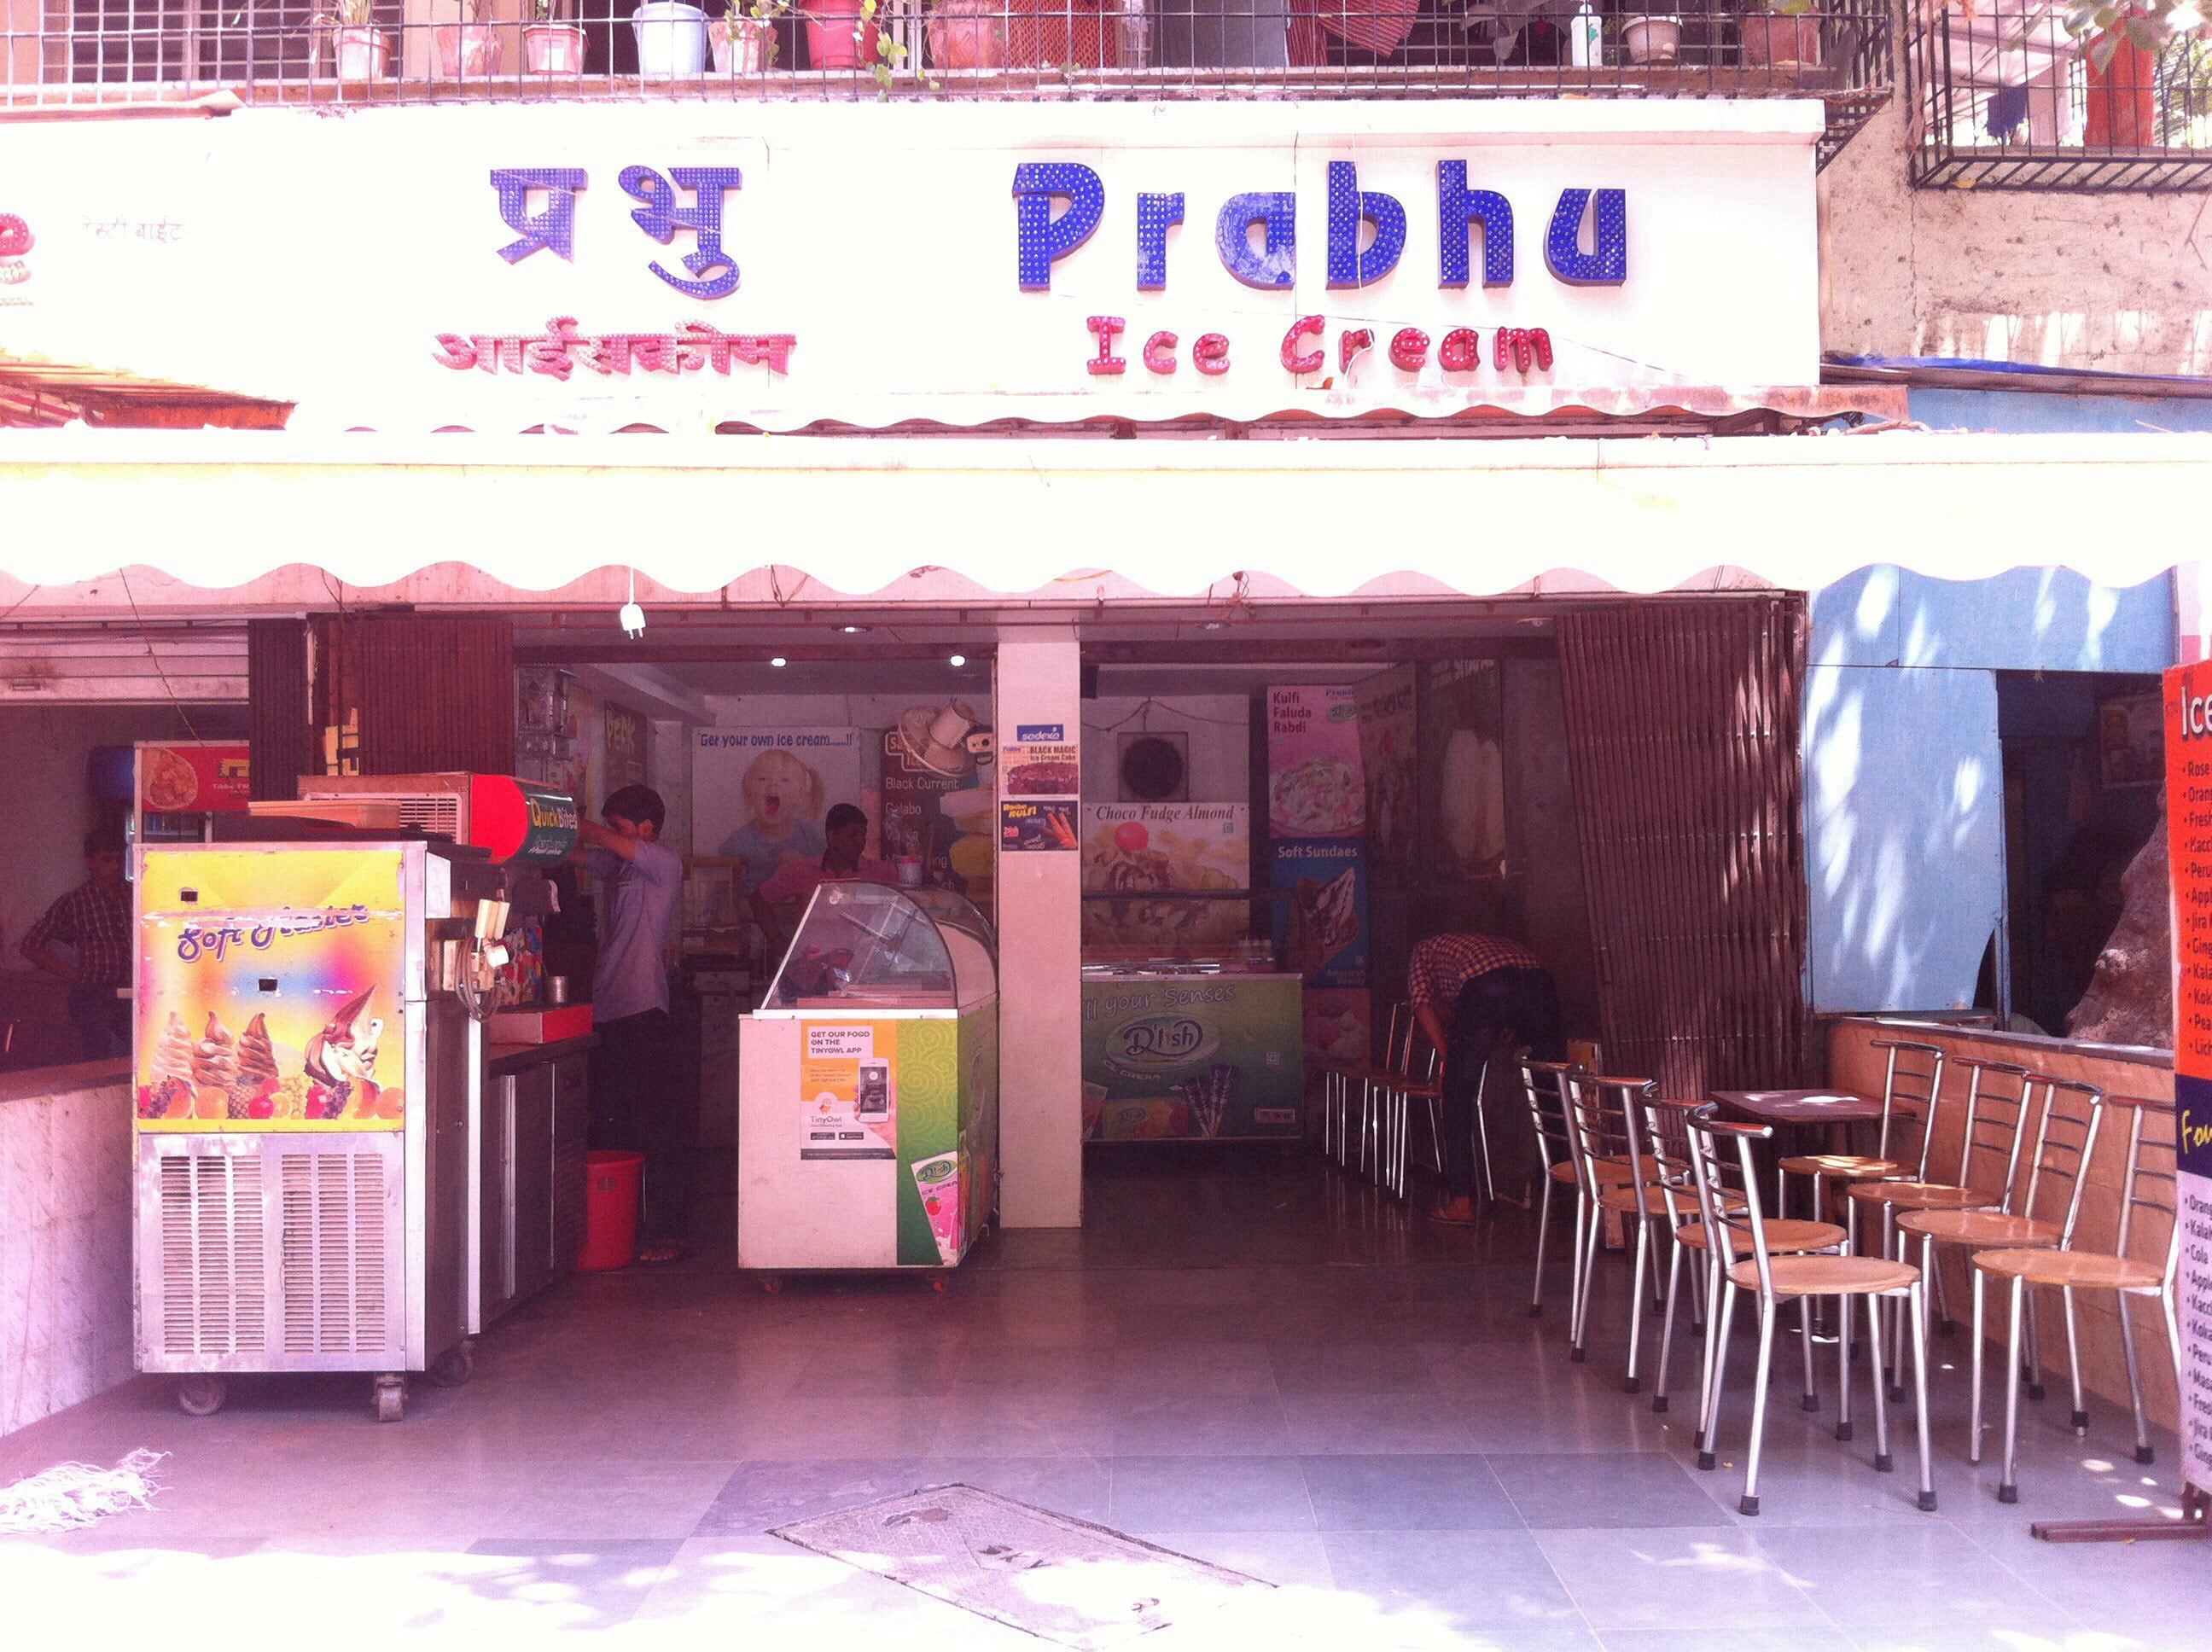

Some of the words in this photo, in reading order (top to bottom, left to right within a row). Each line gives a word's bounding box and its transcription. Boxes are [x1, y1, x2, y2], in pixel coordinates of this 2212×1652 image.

[490, 166, 742, 300] प्रभु
[1012, 159, 1627, 292] Prabhu
[1086, 315, 1231, 376] Ice
[1280, 314, 1555, 378] Cream
[1273, 690, 1300, 704] Kulfi
[1273, 706, 1312, 718] Faluda
[1273, 720, 1307, 733] Rabdi
[722, 735, 748, 748] your
[751, 735, 774, 747] own
[1029, 746, 1052, 754] BLACK
[1053, 746, 1076, 754] MAGIC
[2187, 760, 2210, 777] Rose
[885, 776, 914, 790] Black
[917, 776, 960, 790] Current
[1097, 806, 1136, 820] Choco
[1140, 805, 1182, 823] Fudge
[1184, 805, 1234, 820] Almond
[1278, 845, 1302, 858] Soft
[1305, 845, 1358, 858] Sundaes
[1104, 992, 1156, 1018] your
[1164, 985, 1237, 1007] Senses
[2194, 1013, 2211, 1031] Pea
[2182, 1109, 2212, 1155] Fou
[2191, 1244, 2209, 1265] Cola
